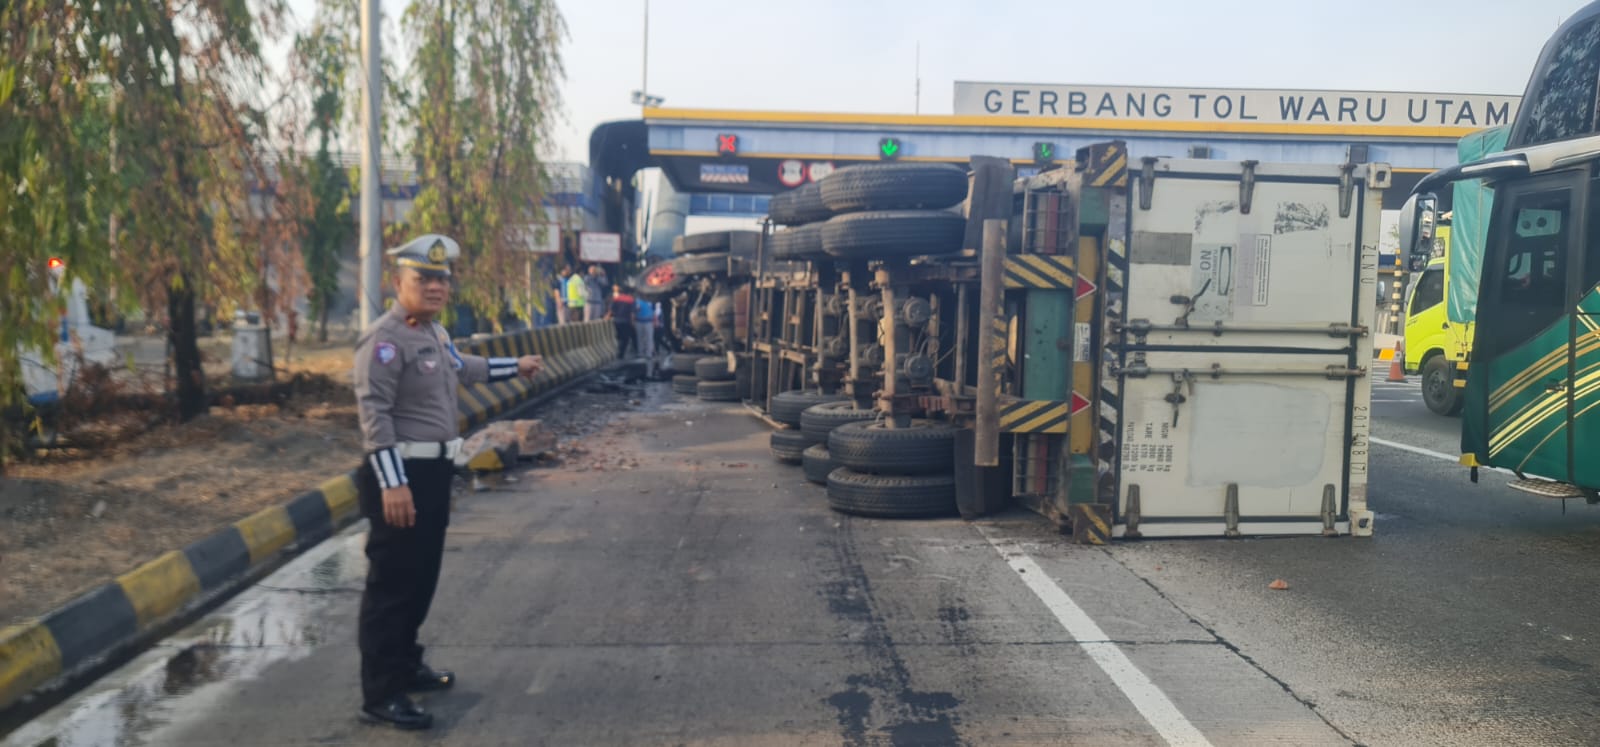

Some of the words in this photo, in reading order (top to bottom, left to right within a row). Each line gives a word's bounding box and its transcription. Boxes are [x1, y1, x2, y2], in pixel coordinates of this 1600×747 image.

[984, 89, 1172, 117] GERBANG
[1188, 94, 1258, 119] TOL
[1279, 96, 1387, 122] WARU
[1407, 98, 1509, 125] UTAM
[1200, 250, 1212, 270] NO
[1361, 245, 1376, 284] ZLNU
[1145, 423, 1153, 439] TARE
[1352, 406, 1367, 455] 201408
